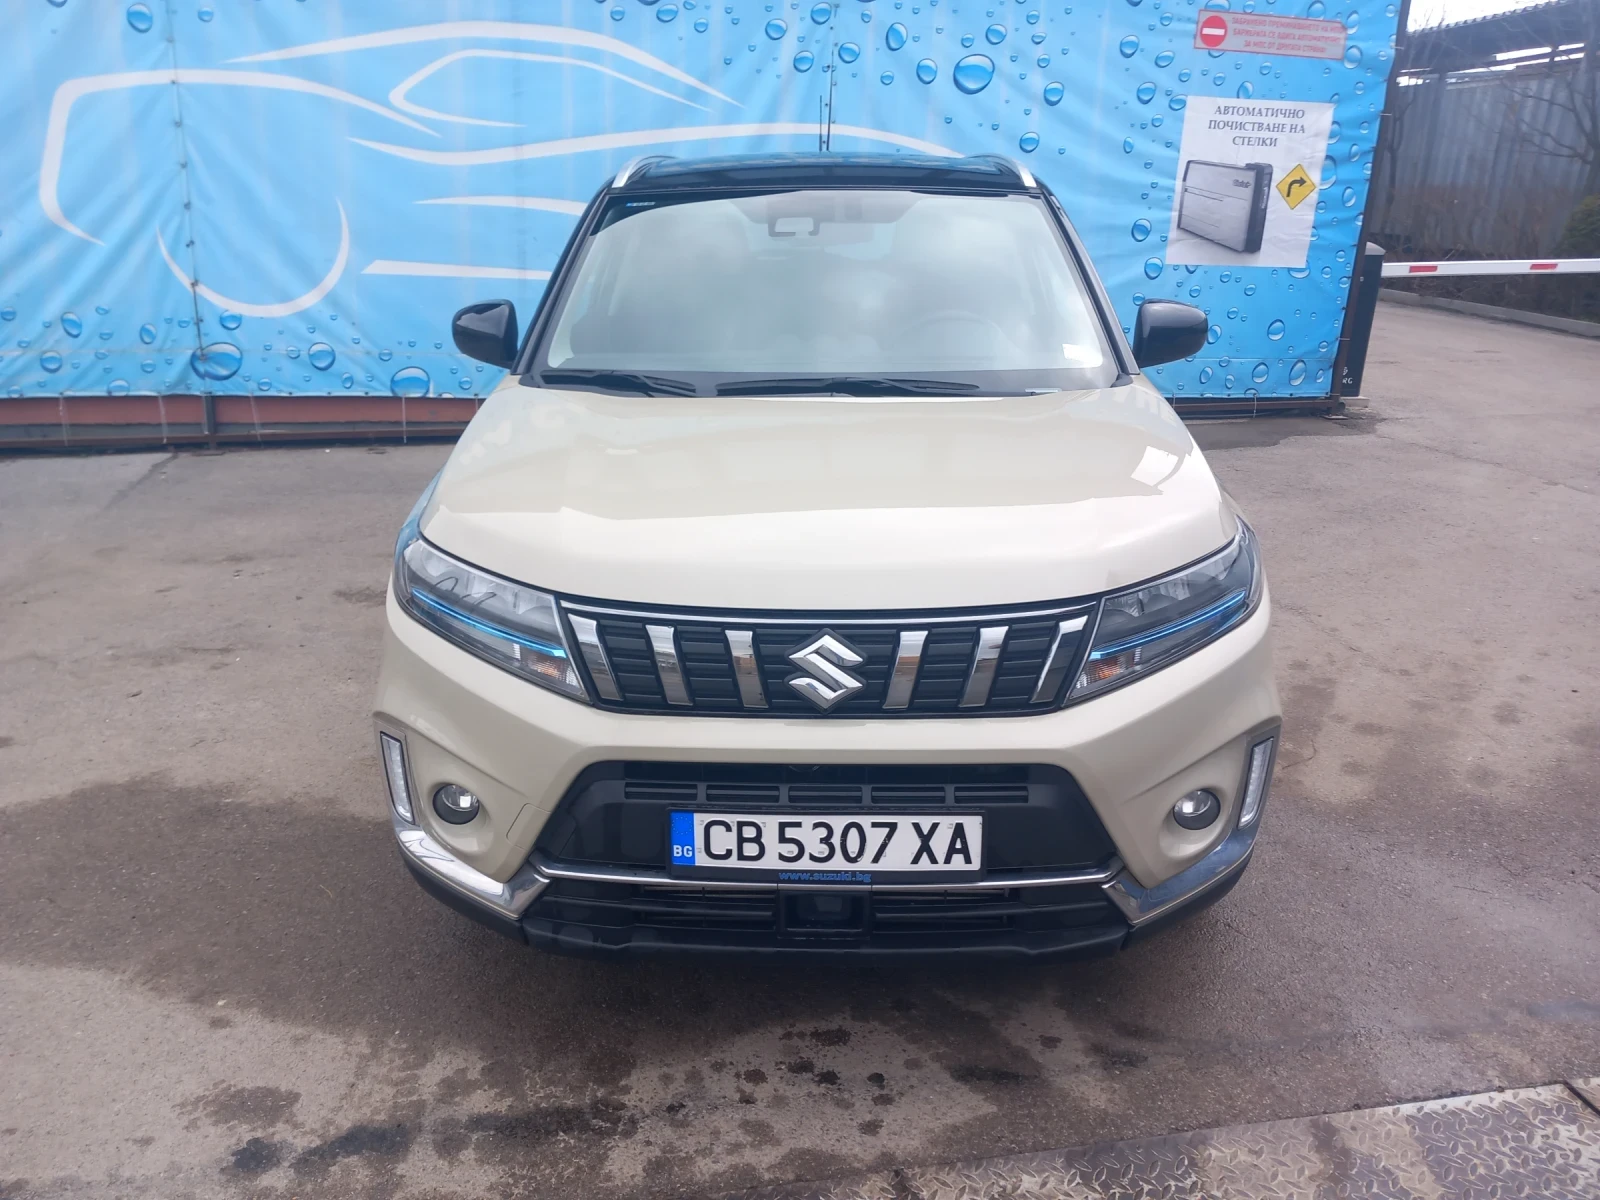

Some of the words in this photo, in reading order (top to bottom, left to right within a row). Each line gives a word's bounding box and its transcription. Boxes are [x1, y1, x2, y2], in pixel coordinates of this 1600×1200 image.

[1214, 105, 1305, 119] АВТОМАТИЧНО
[1208, 119, 1288, 133] ПОЧИСТВАНЕ
[1289, 123, 1305, 134] НА
[1232, 135, 1278, 147] СТЕЛКИ
[703, 819, 766, 862] CB
[777, 820, 899, 865] 5307
[909, 821, 973, 866] XA
[673, 845, 693, 858] BG
[779, 872, 871, 882] www.suzuki.bg
